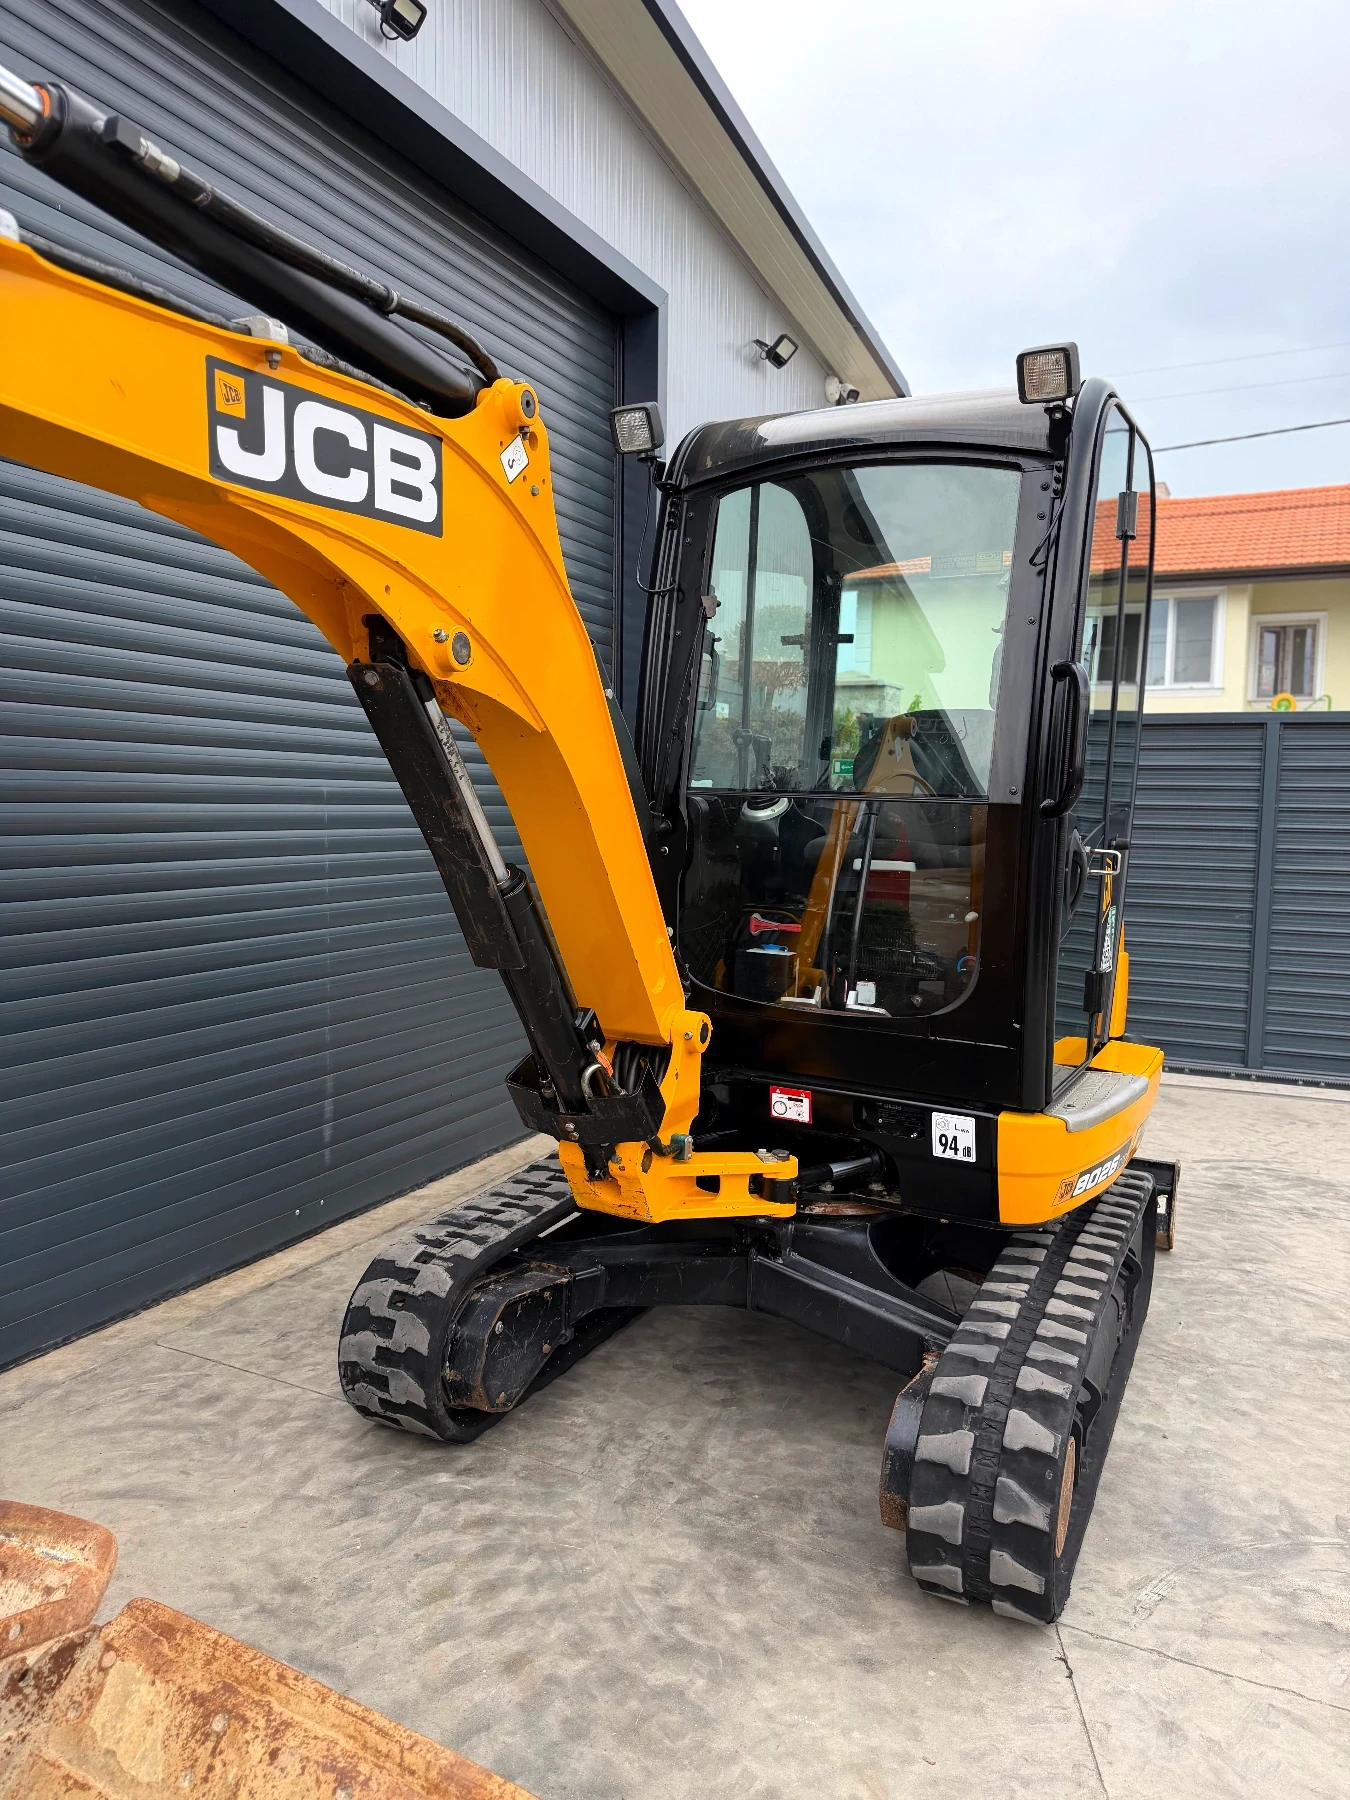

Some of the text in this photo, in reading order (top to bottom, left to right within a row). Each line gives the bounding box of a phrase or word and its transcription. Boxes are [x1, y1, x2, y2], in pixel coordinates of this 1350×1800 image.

[223, 383, 241, 403] JCB
[216, 385, 438, 523] JCB
[938, 1133, 972, 1158] 94 dB
[1073, 1154, 1120, 1196] 8026
